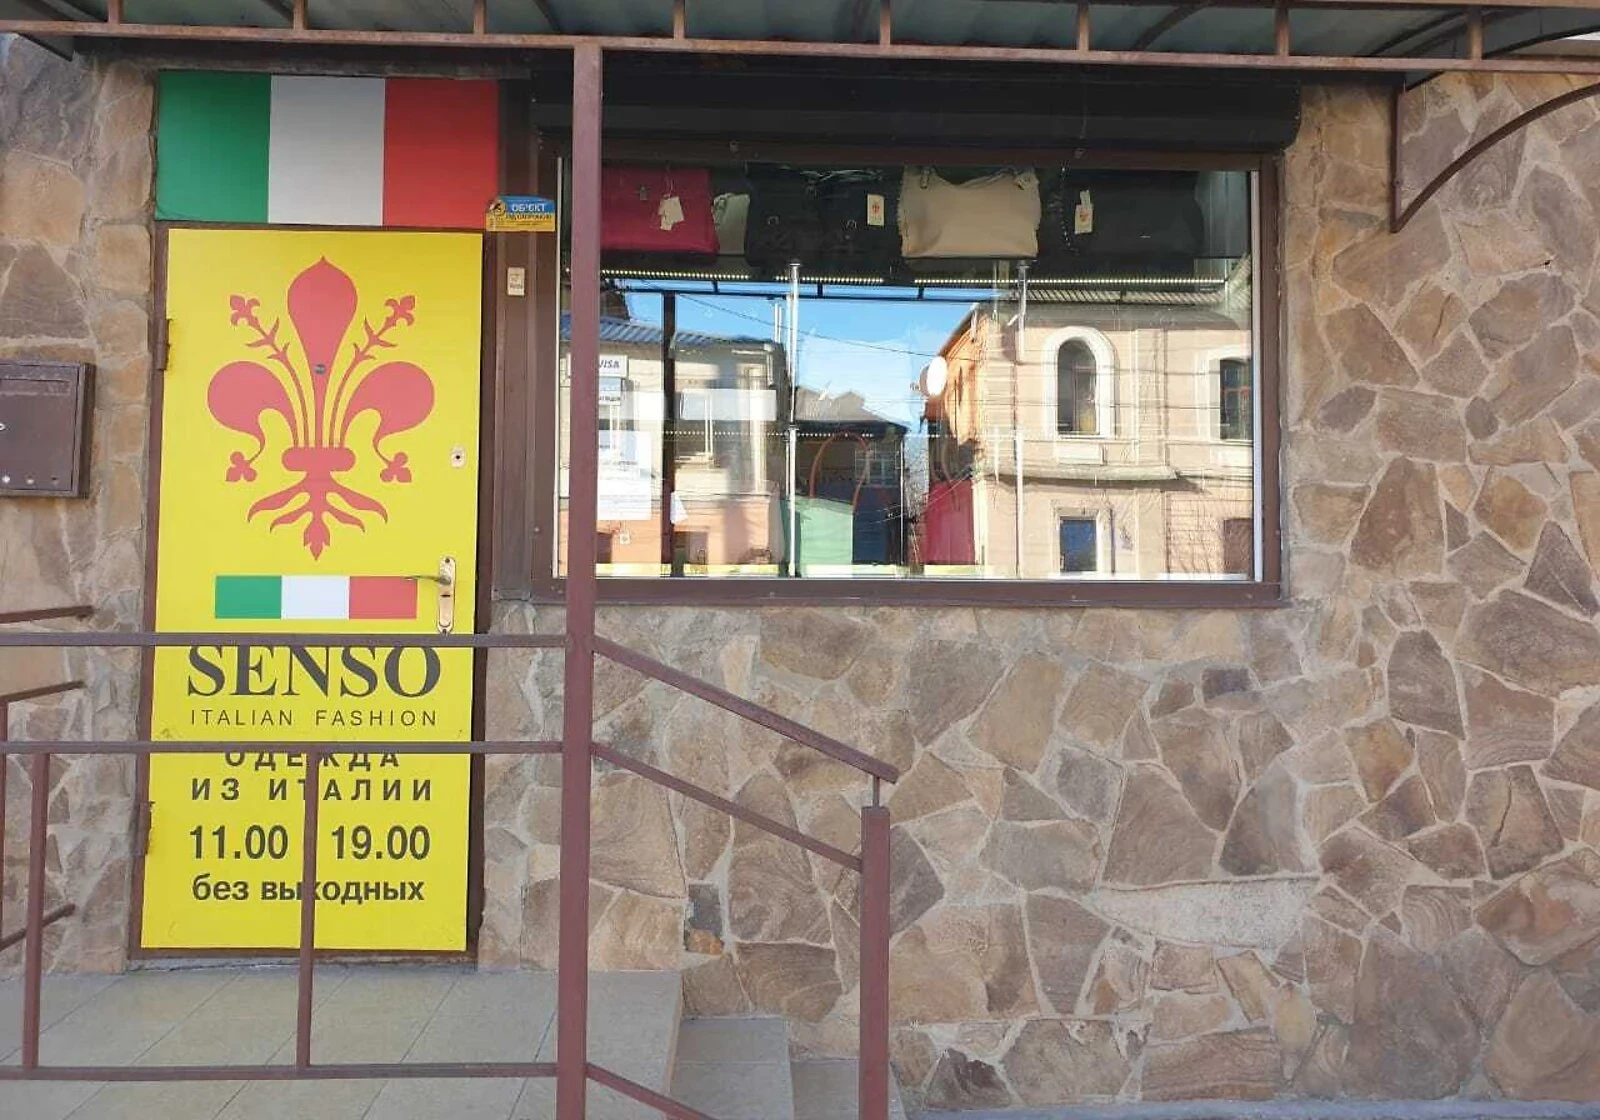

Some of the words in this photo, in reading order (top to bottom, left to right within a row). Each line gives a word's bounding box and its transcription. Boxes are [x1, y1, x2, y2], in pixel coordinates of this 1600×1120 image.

[188, 645, 441, 697] SENSO
[191, 709, 292, 725] ITALIAN
[315, 710, 436, 726] FASHION
[192, 778, 240, 801] ИЗ
[189, 824, 288, 859] 11.00
[331, 825, 431, 860] 19.00
[192, 873, 249, 901] без
